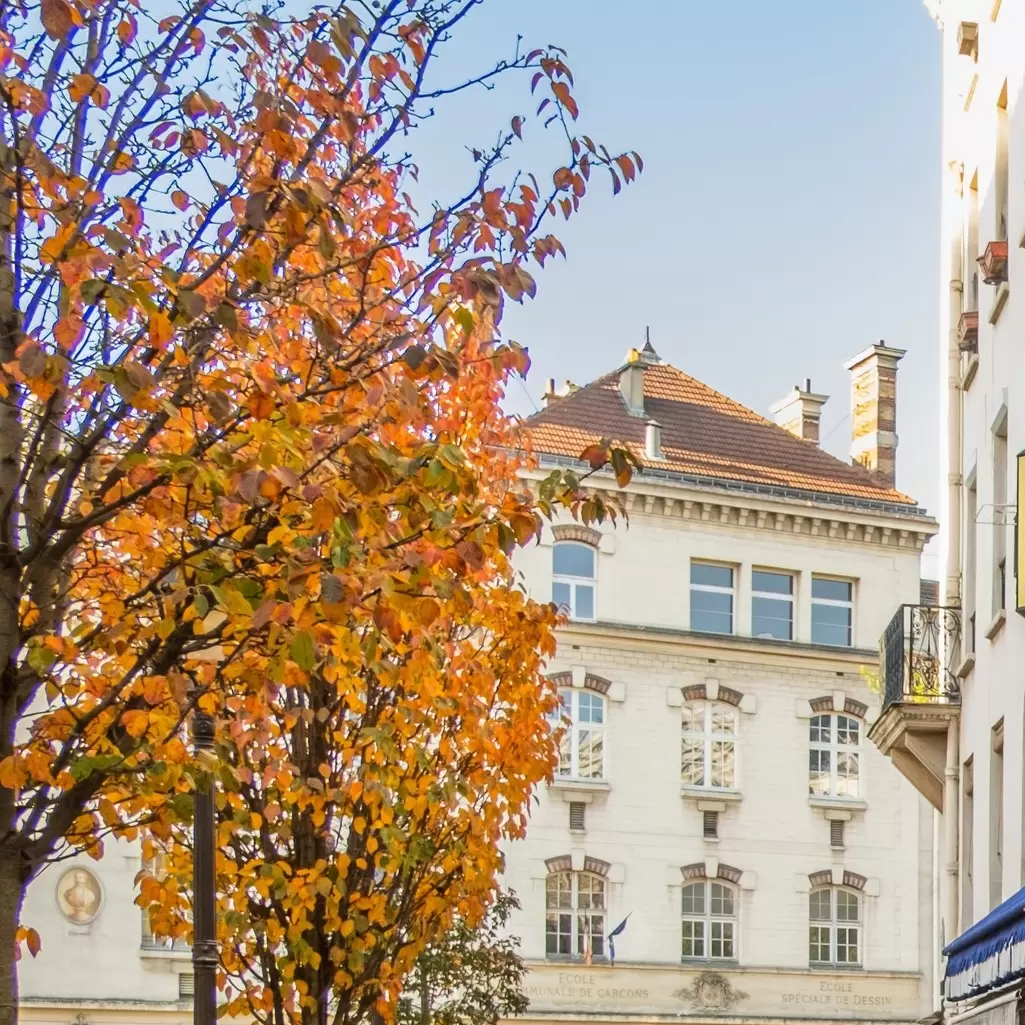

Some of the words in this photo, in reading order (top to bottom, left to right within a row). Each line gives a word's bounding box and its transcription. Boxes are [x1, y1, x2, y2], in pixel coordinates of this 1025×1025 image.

[579, 987, 593, 998] DE
[836, 995, 849, 1005] DE
[854, 994, 893, 1006] DESSIN
